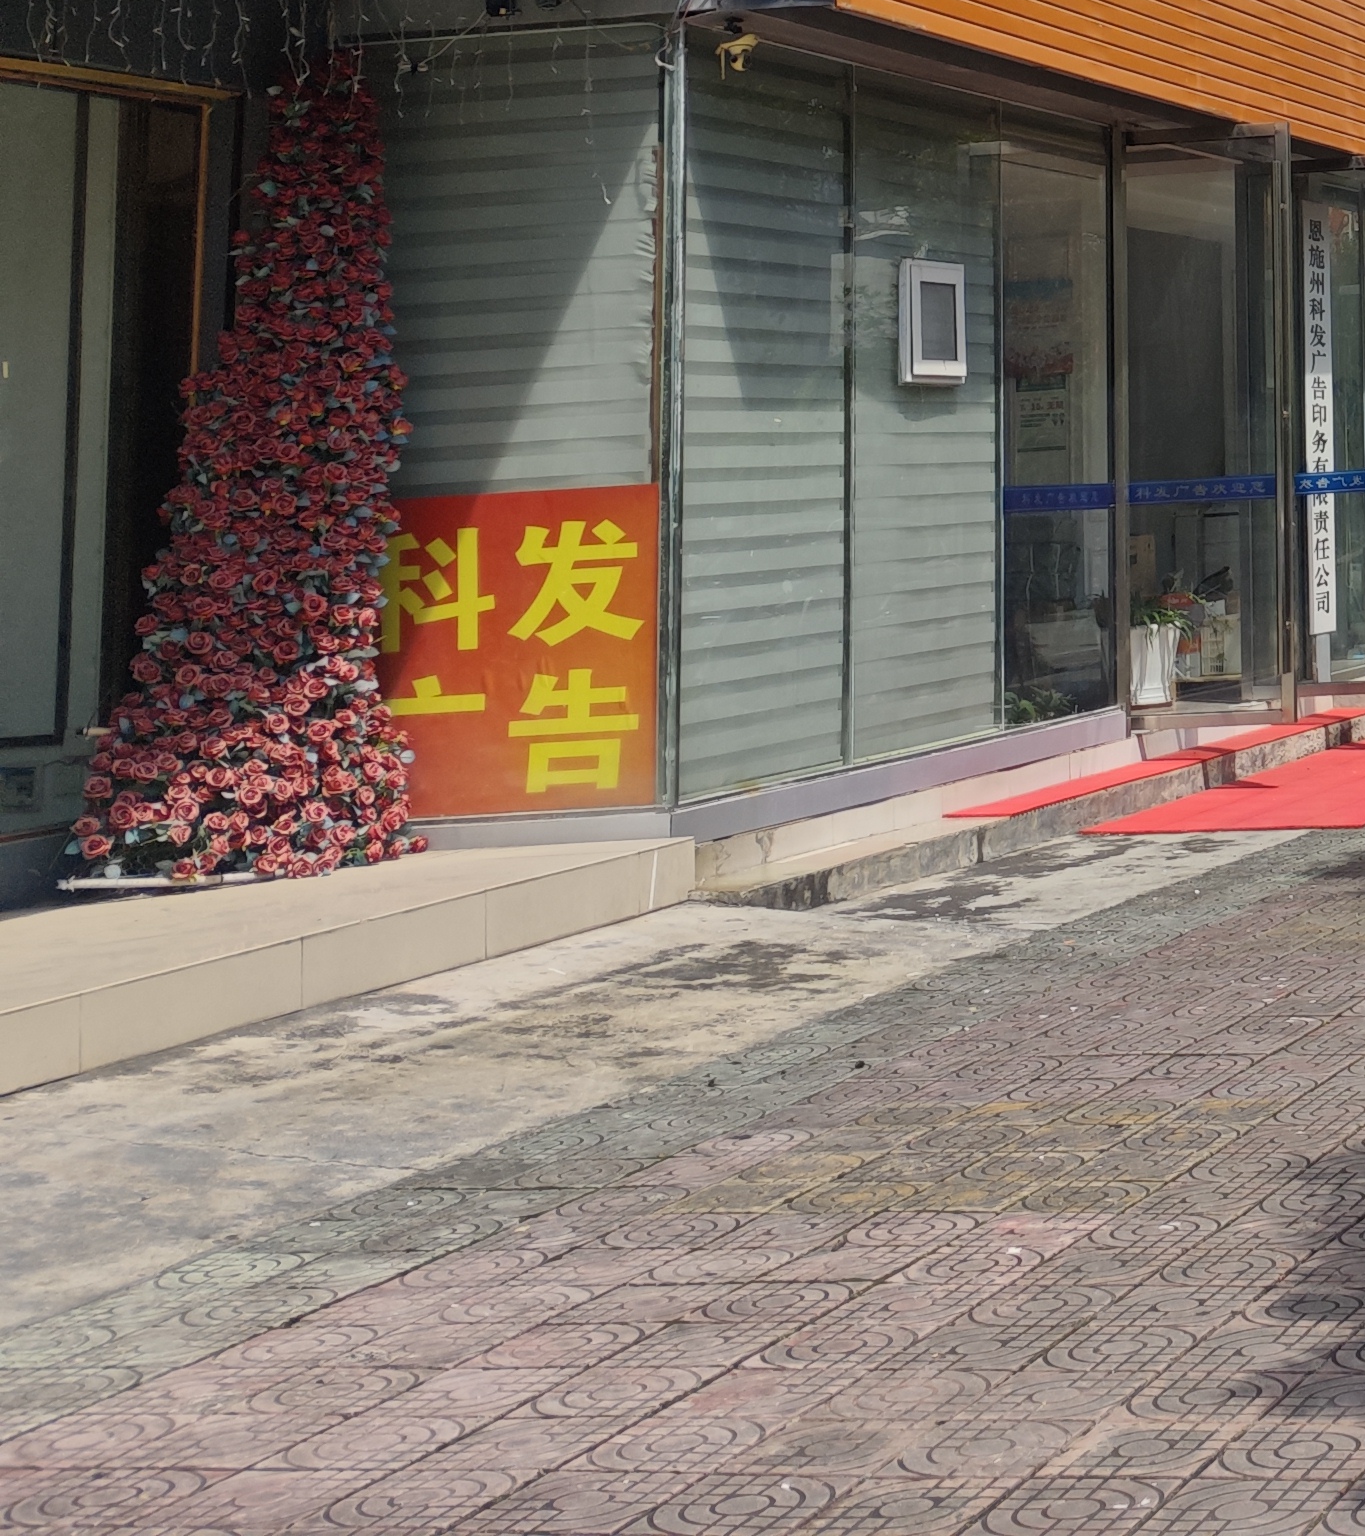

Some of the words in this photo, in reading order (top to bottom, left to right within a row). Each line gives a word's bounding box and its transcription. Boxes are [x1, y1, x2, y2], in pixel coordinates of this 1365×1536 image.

[1308, 218, 1331, 614] 恩施州科发广告印务有限责任公司
[380, 519, 645, 653] 科发
